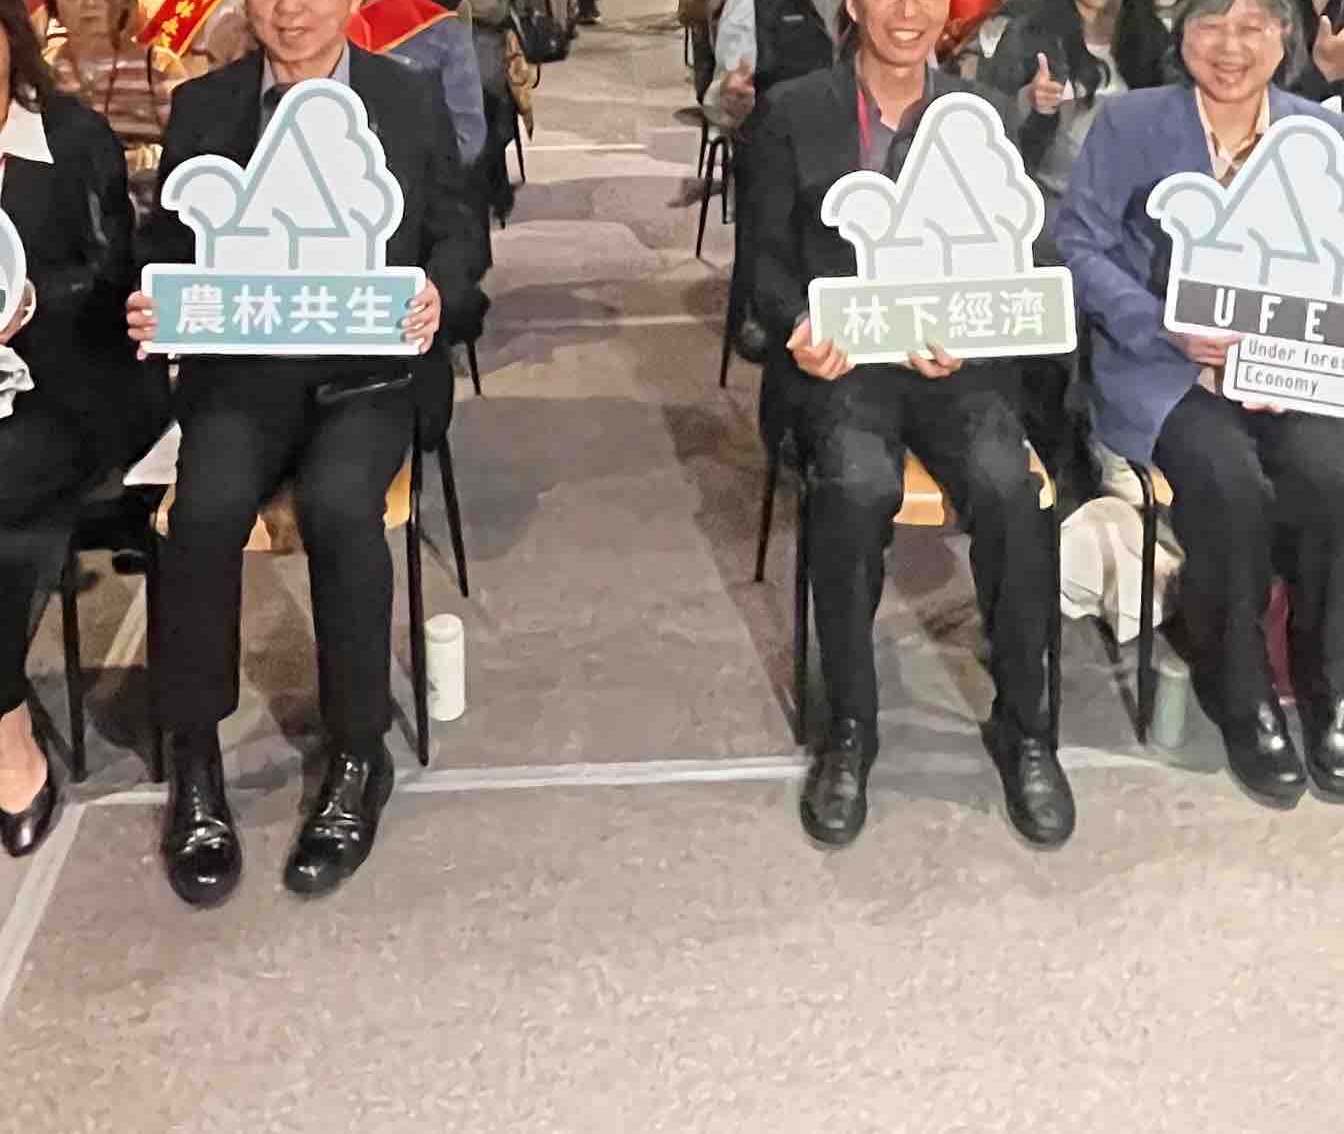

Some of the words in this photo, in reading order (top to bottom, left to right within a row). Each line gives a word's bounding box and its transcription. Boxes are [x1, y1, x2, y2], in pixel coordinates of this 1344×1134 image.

[176, 283, 394, 335] 農林共生
[842, 287, 1047, 345] 林下經濟
[1247, 336, 1296, 362] Under
[1243, 367, 1320, 396] Economy
